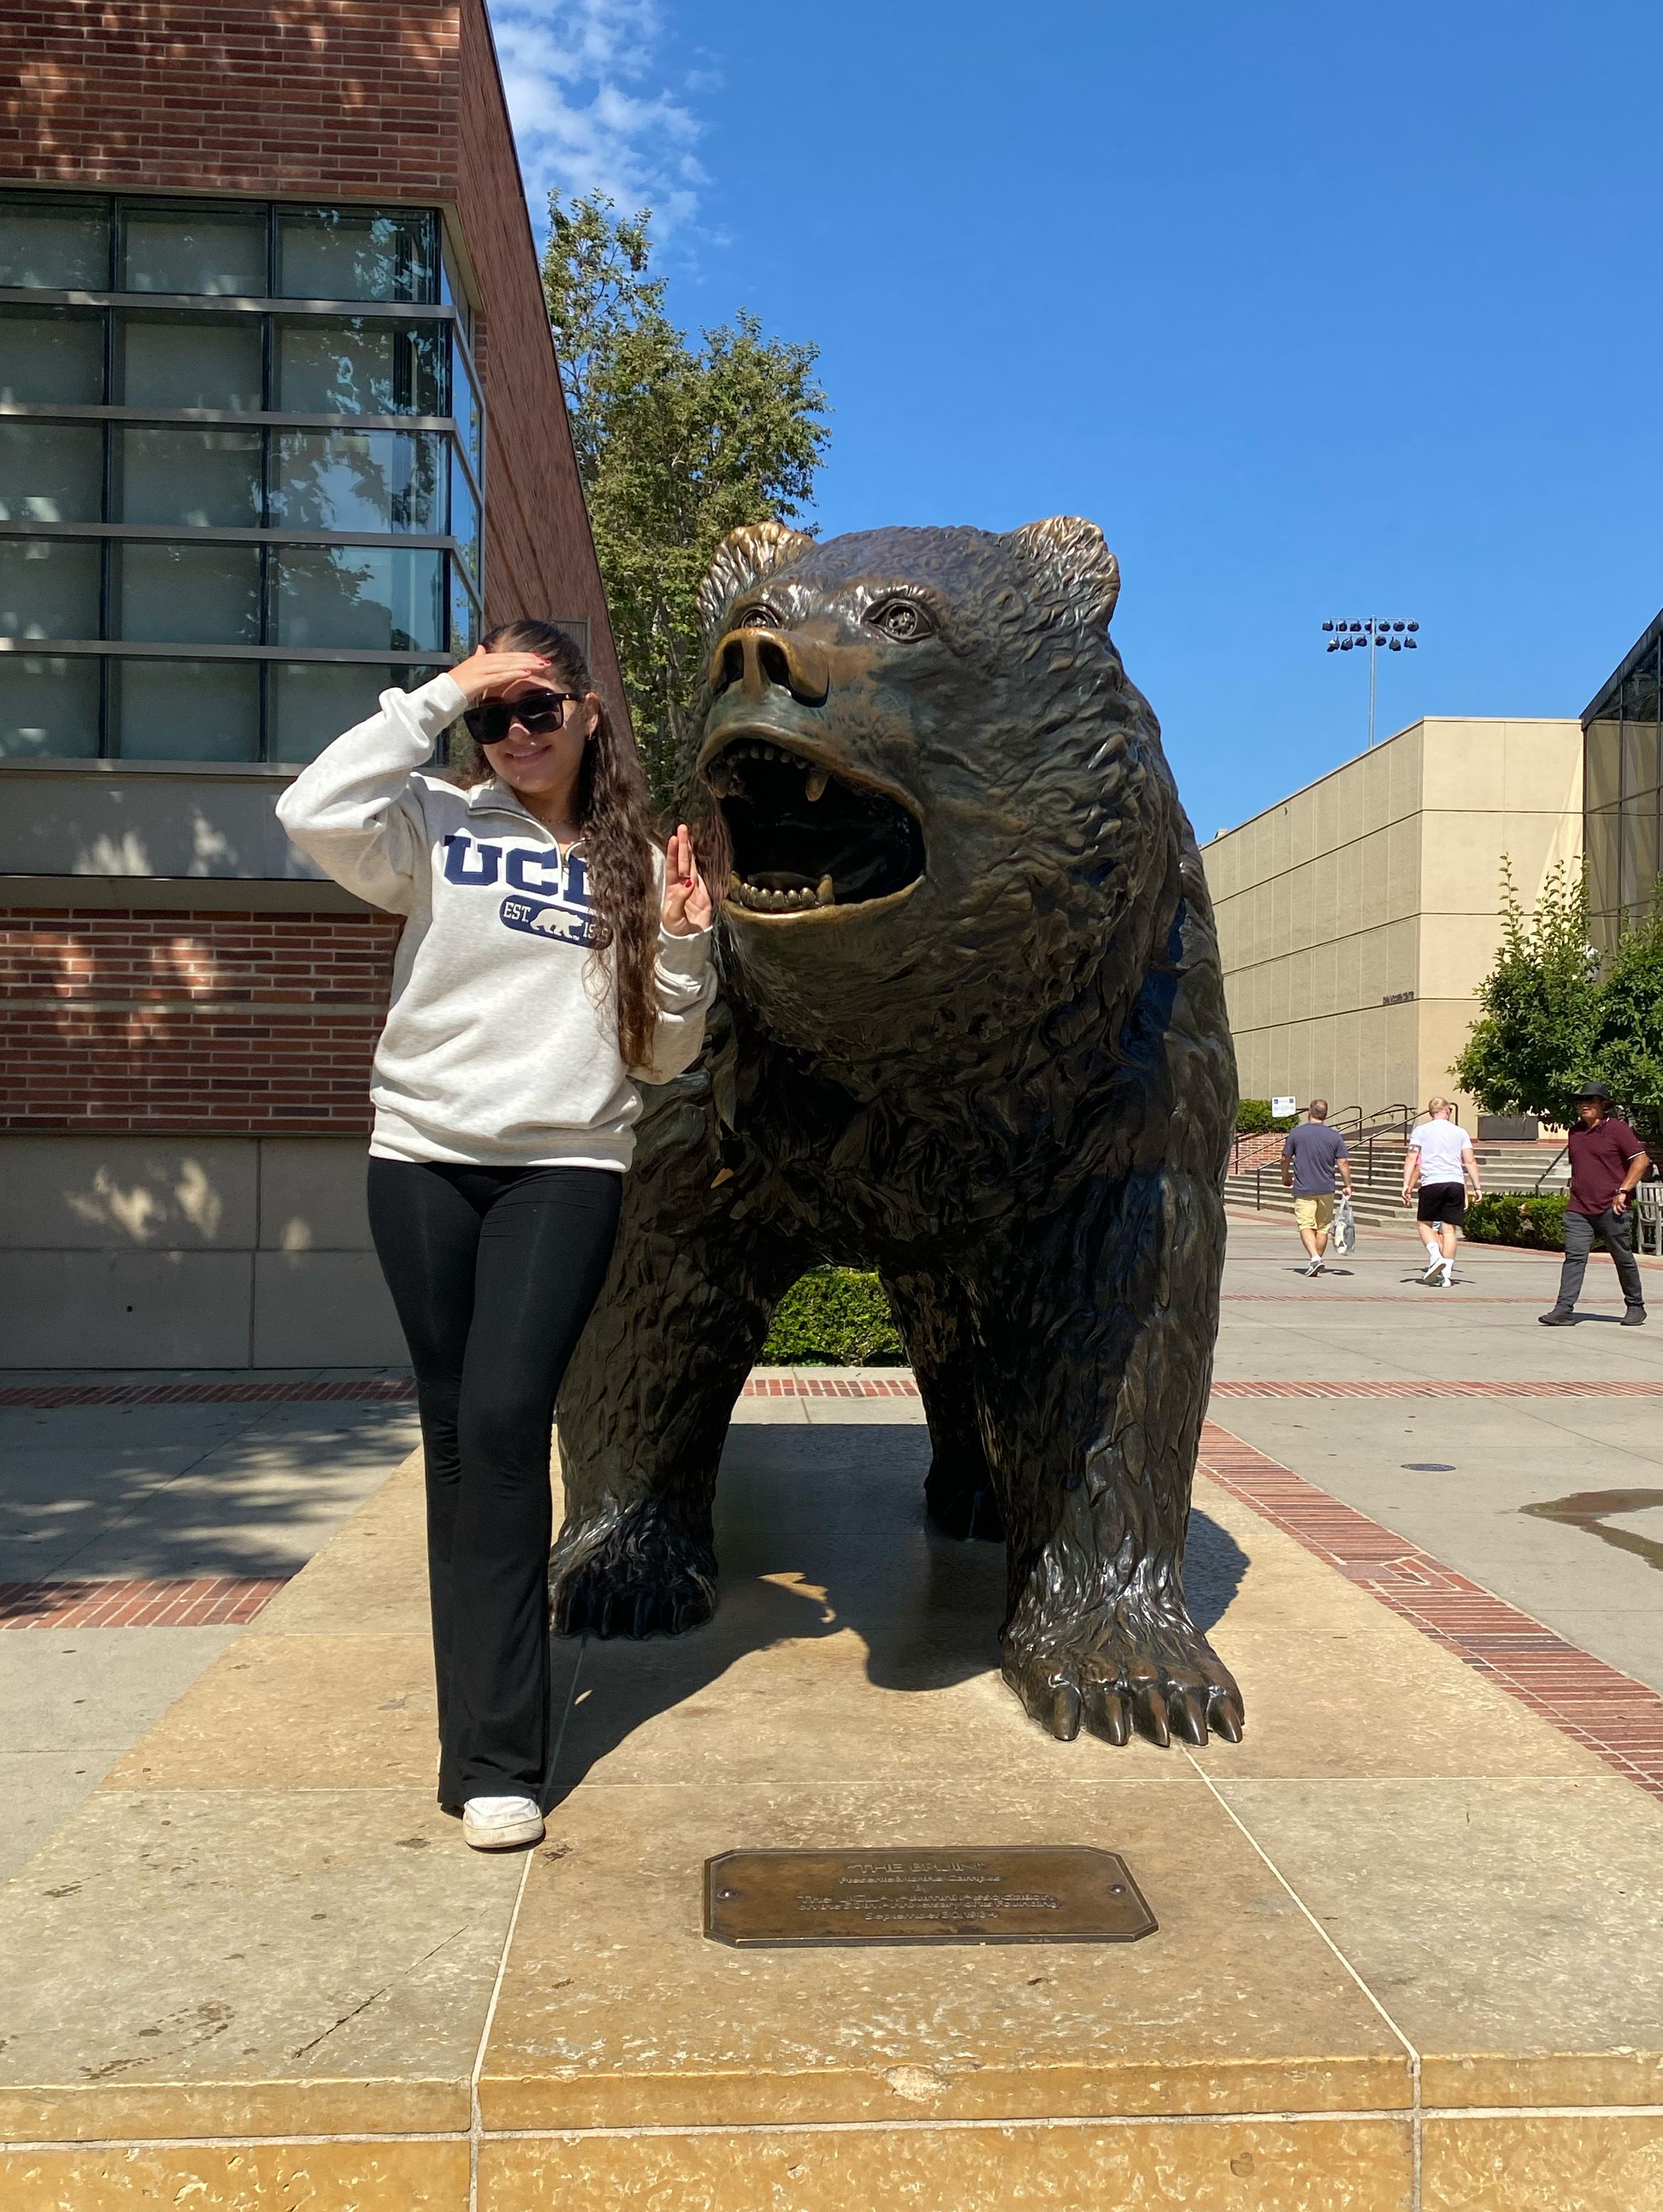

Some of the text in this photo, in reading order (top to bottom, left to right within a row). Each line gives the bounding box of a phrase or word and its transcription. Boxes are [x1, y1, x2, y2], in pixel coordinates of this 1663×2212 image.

[444, 834, 593, 906] UCL
[503, 901, 531, 923] EST.
[945, 1874, 1001, 1884] Campus
[865, 1911, 939, 1921] September
